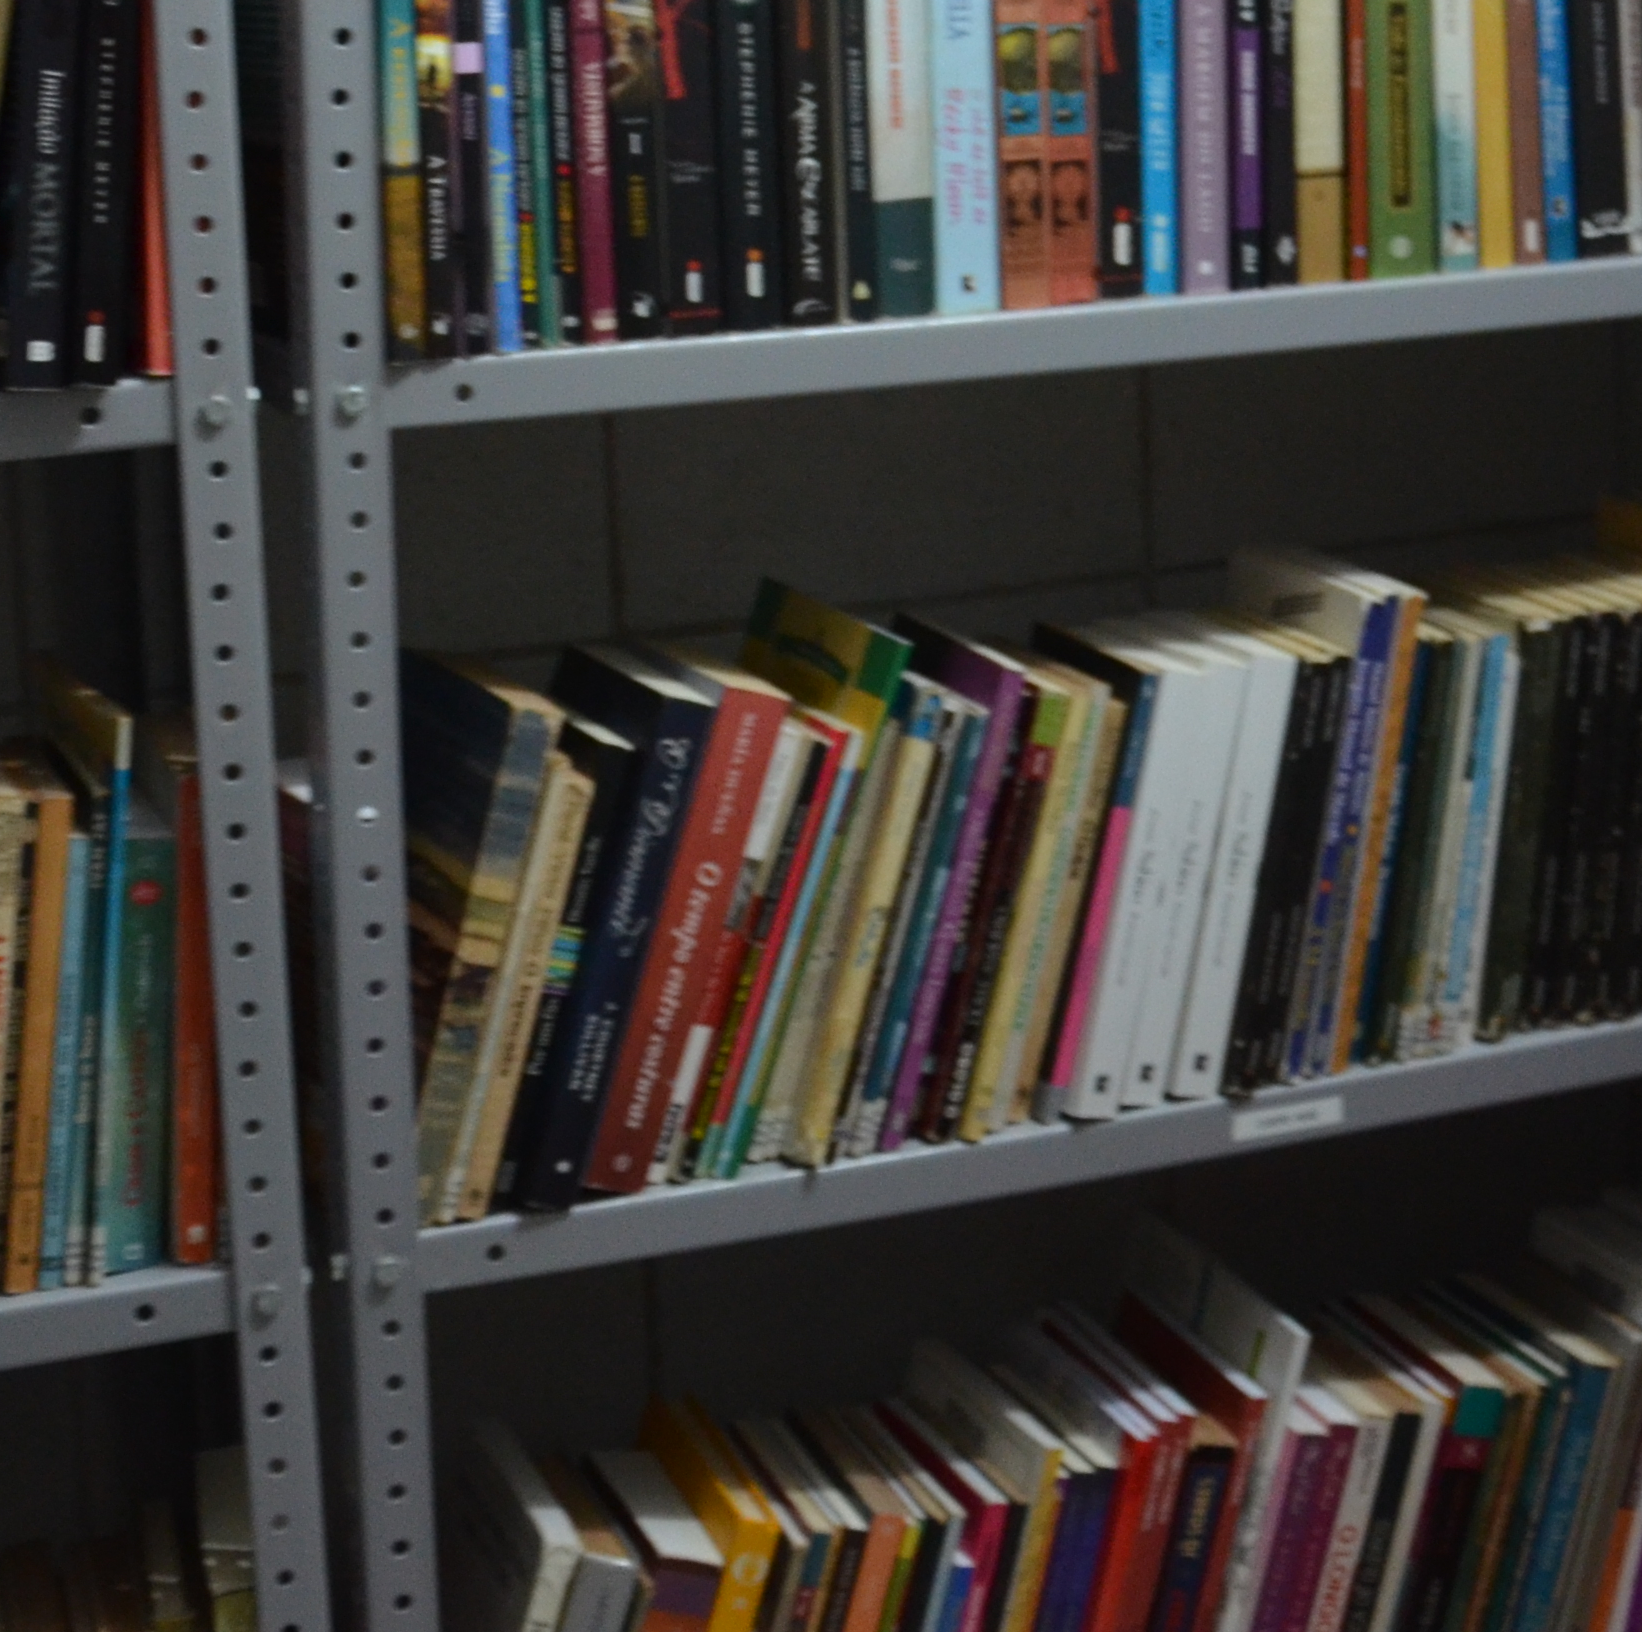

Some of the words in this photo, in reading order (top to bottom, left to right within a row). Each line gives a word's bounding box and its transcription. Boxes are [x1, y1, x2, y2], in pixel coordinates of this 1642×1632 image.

[36, 68, 67, 155] Imitação
[96, 37, 116, 148] STEPHENIE
[582, 61, 605, 165] NORMALISTA
[737, 23, 757, 139] STEPHENIE
[427, 154, 444, 169] A
[792, 96, 816, 154] ARMA
[93, 161, 110, 225] MEYER
[429, 173, 448, 262] TRAVESSIA
[743, 148, 761, 218] MEYER
[795, 156, 821, 281] ESCARLATE
[26, 161, 64, 296] MORTAL
[695, 862, 724, 888] O
[667, 887, 714, 964] tempo
[651, 965, 691, 1032] entre
[624, 1033, 671, 1130] costuras
[1336, 1523, 1360, 1546] O
